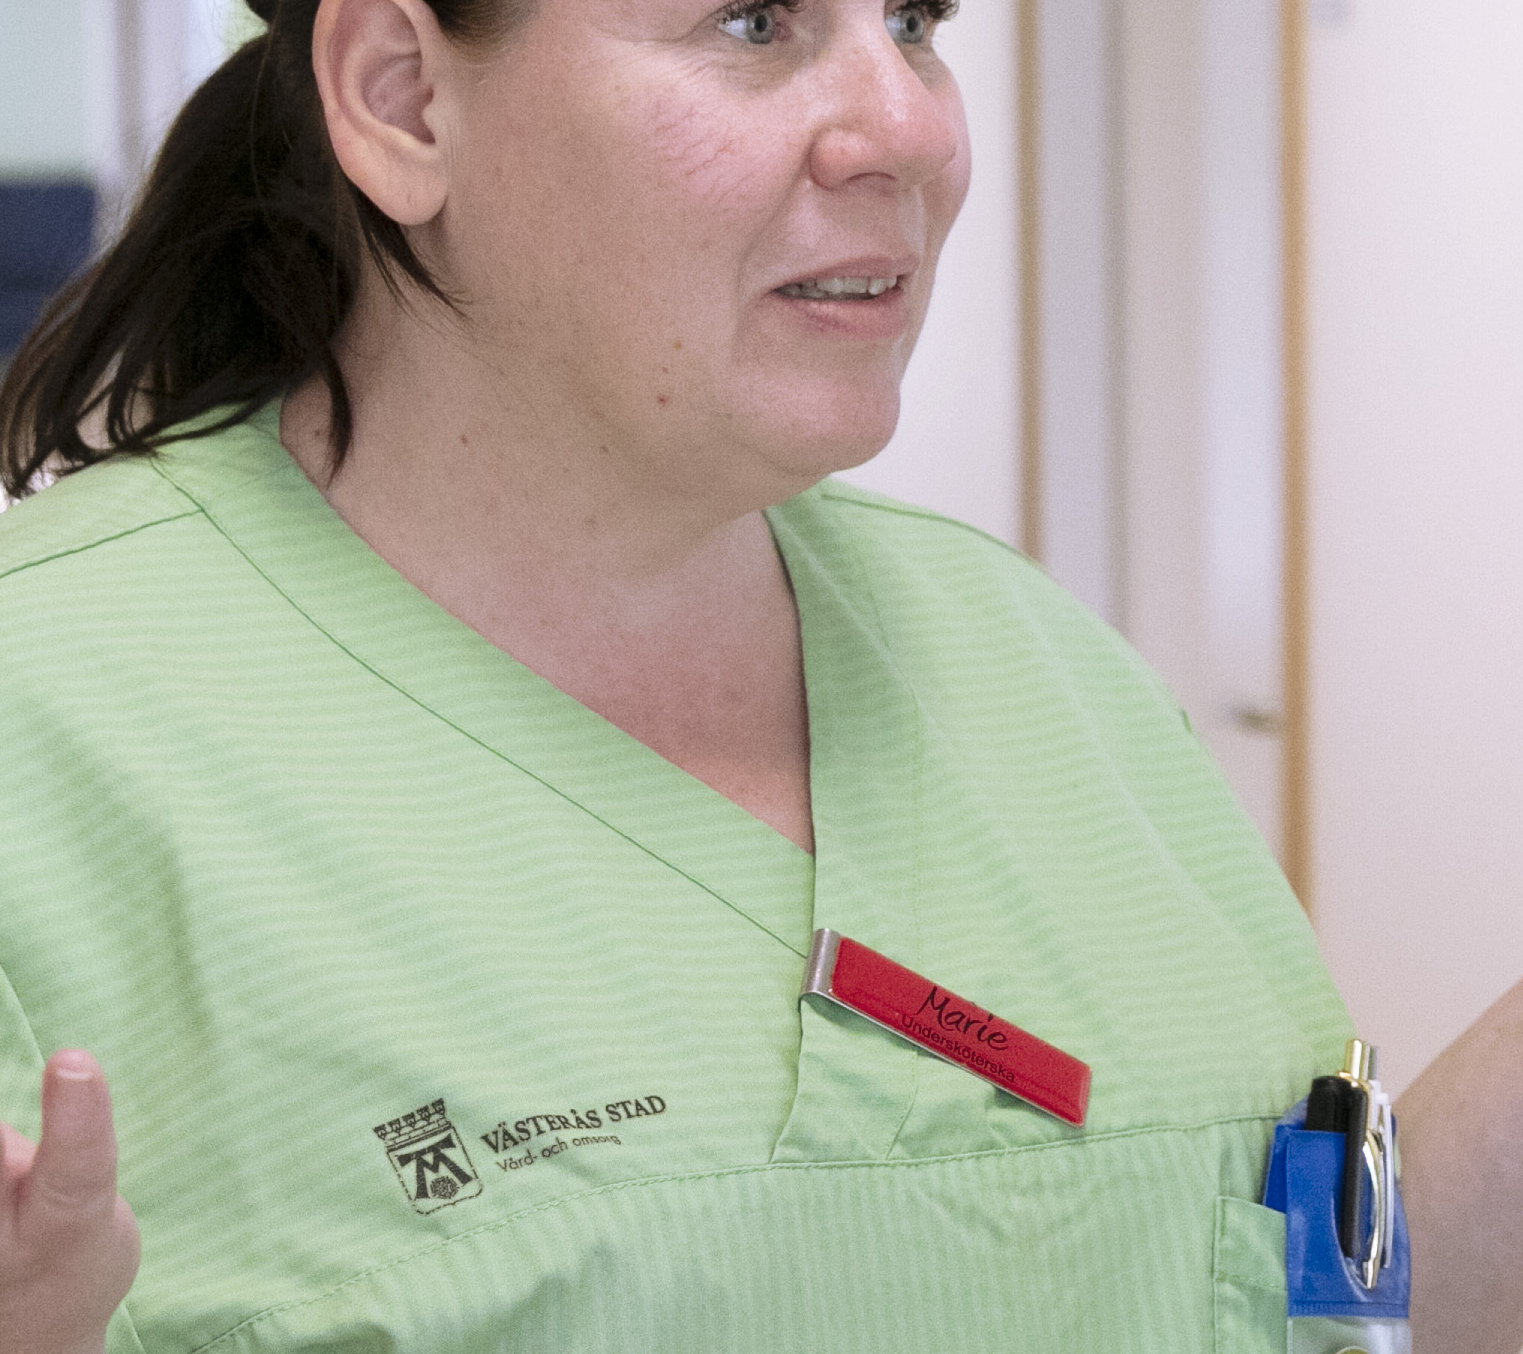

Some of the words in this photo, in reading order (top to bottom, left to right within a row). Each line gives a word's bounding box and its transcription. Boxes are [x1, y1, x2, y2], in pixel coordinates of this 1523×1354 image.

[902, 1013, 1015, 1082] Undersköterska
[916, 986, 1008, 1050] Marie
[480, 1108, 602, 1153] VÄSTERÅS
[605, 1095, 666, 1122] STAD
[495, 1149, 537, 1172] Vård-
[541, 1137, 568, 1158] och
[572, 1134, 621, 1145] omsorg
